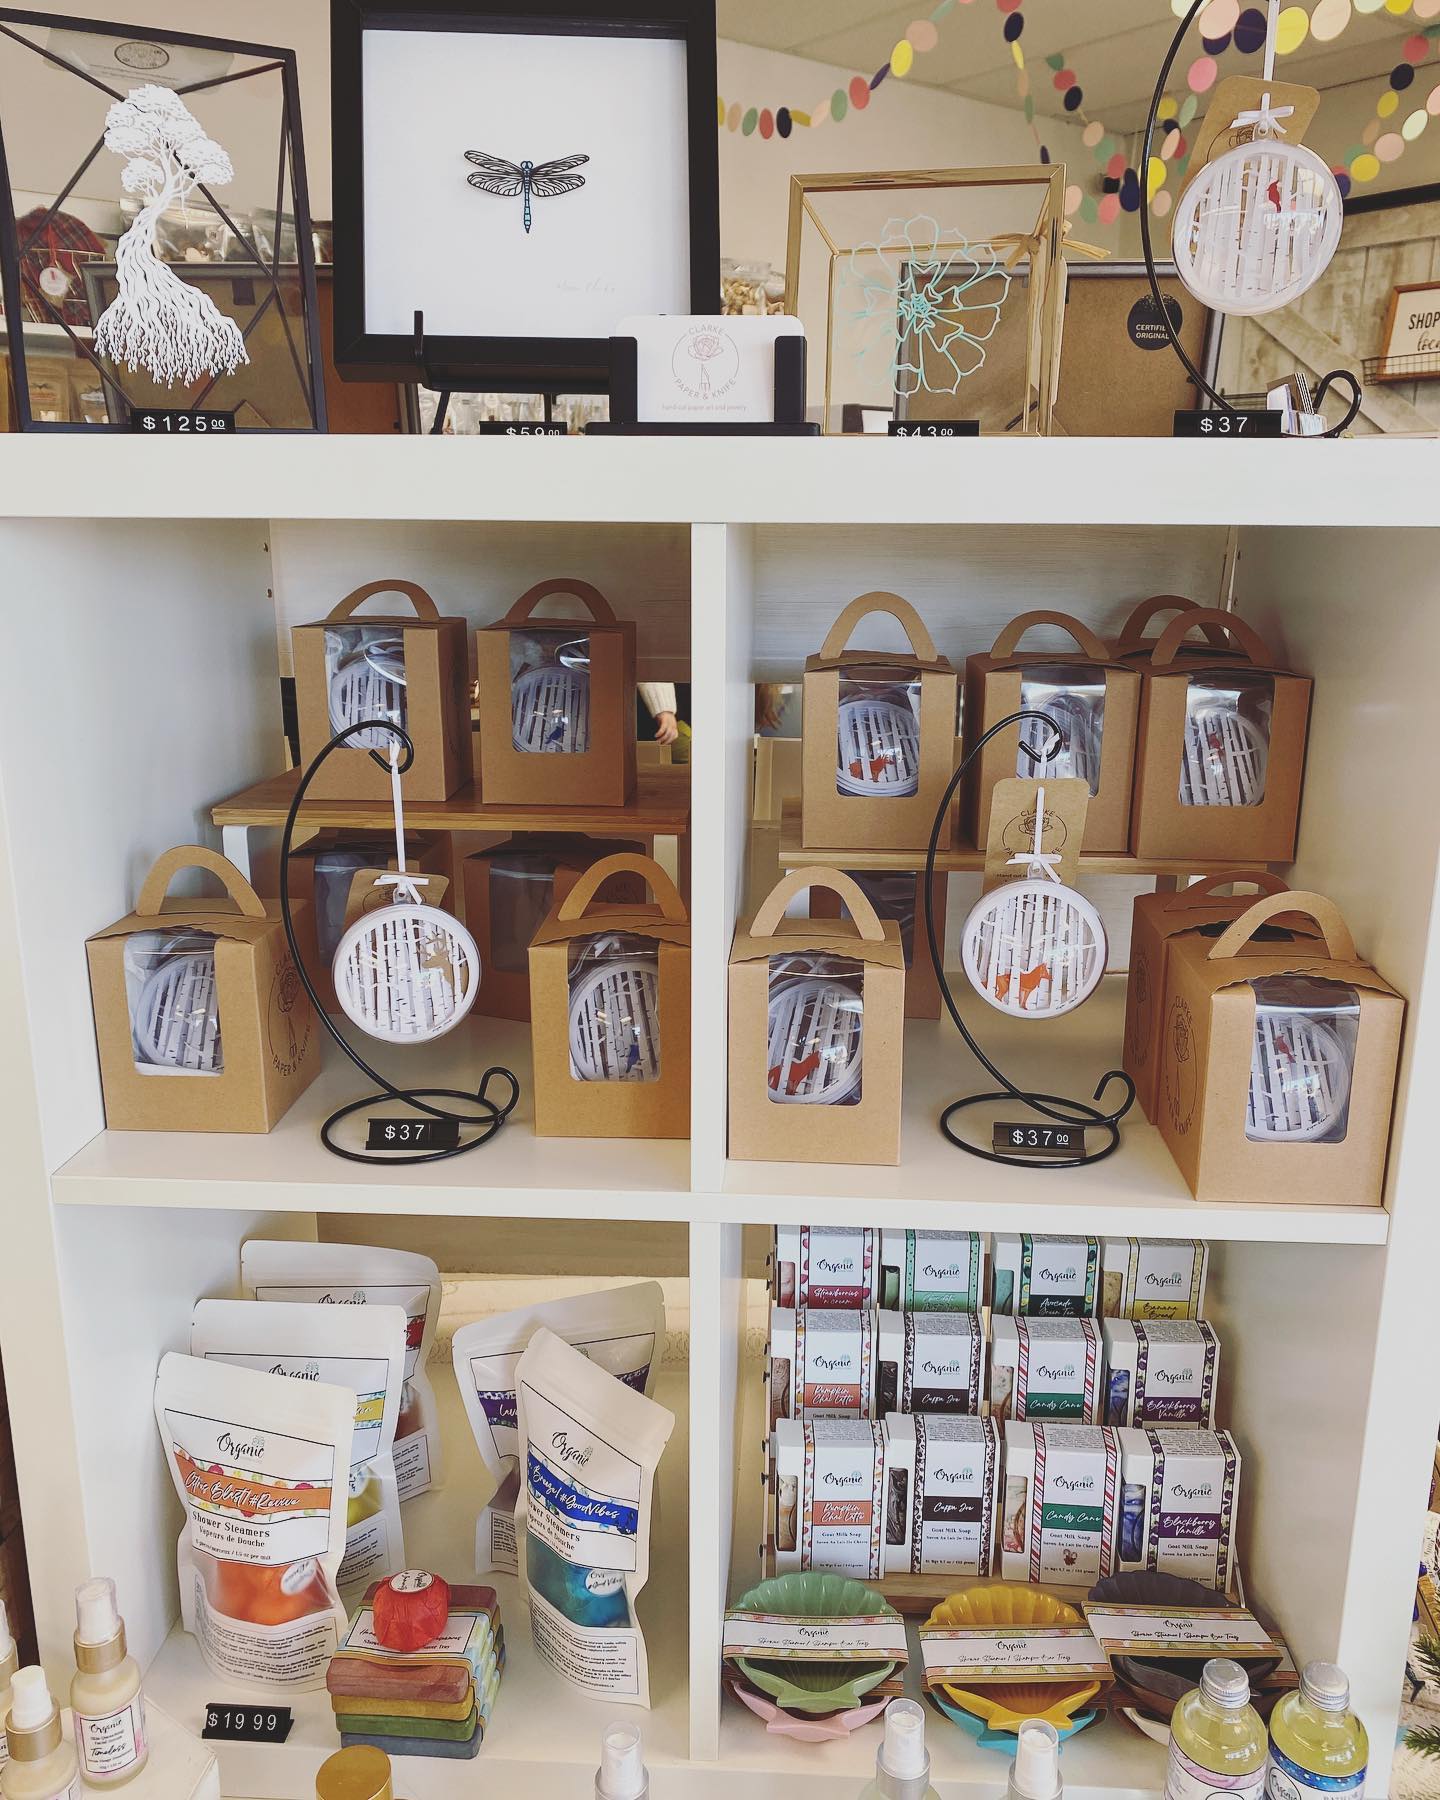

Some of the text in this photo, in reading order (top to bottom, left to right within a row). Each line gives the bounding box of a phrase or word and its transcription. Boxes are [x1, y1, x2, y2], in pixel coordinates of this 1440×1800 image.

[1135, 324, 1167, 332] CERTIFI
[1135, 332, 1170, 340] ORIGINAL
[1200, 416, 1248, 434] $37
[1020, 809, 1055, 818] CLAKE
[384, 1124, 425, 1141] $37
[817, 1259, 853, 1273] Organic
[923, 1264, 960, 1279] Organic
[1039, 1268, 1077, 1282] Organic
[1145, 1272, 1182, 1287] Organic
[1040, 1297, 1072, 1307] Avocado
[1143, 1301, 1179, 1311] Banana
[1148, 1310, 1174, 1320] Bread
[813, 1355, 851, 1370] Organic
[921, 1360, 960, 1375] Organic
[1036, 1366, 1075, 1380] Organic
[1154, 1369, 1193, 1384] Organic
[1029, 1399, 1082, 1411] Candy Cane
[1147, 1400, 1197, 1413] Blackberry
[1158, 1409, 1187, 1419] Vanilla
[216, 1432, 265, 1461] Organic
[552, 1431, 592, 1468] Organic
[822, 1472, 863, 1486] Organic
[933, 1470, 974, 1484] Organic
[1053, 1476, 1095, 1491] Organic
[1171, 1484, 1213, 1499] Organic
[821, 1511, 842, 1523] Chai
[1045, 1510, 1101, 1523] Candy Cane
[1163, 1515, 1217, 1530] Blackberry
[193, 1511, 271, 1538] Shower Steamers
[545, 1513, 581, 1542] Steamers
[1175, 1525, 1206, 1537] Vanilla
[226, 1534, 236, 1542] de
[237, 1536, 266, 1548] Douche
[1225, 1632, 1240, 1642] Tray
[995, 1640, 1028, 1652] Organic
[90, 1743, 127, 1757] Timeless
